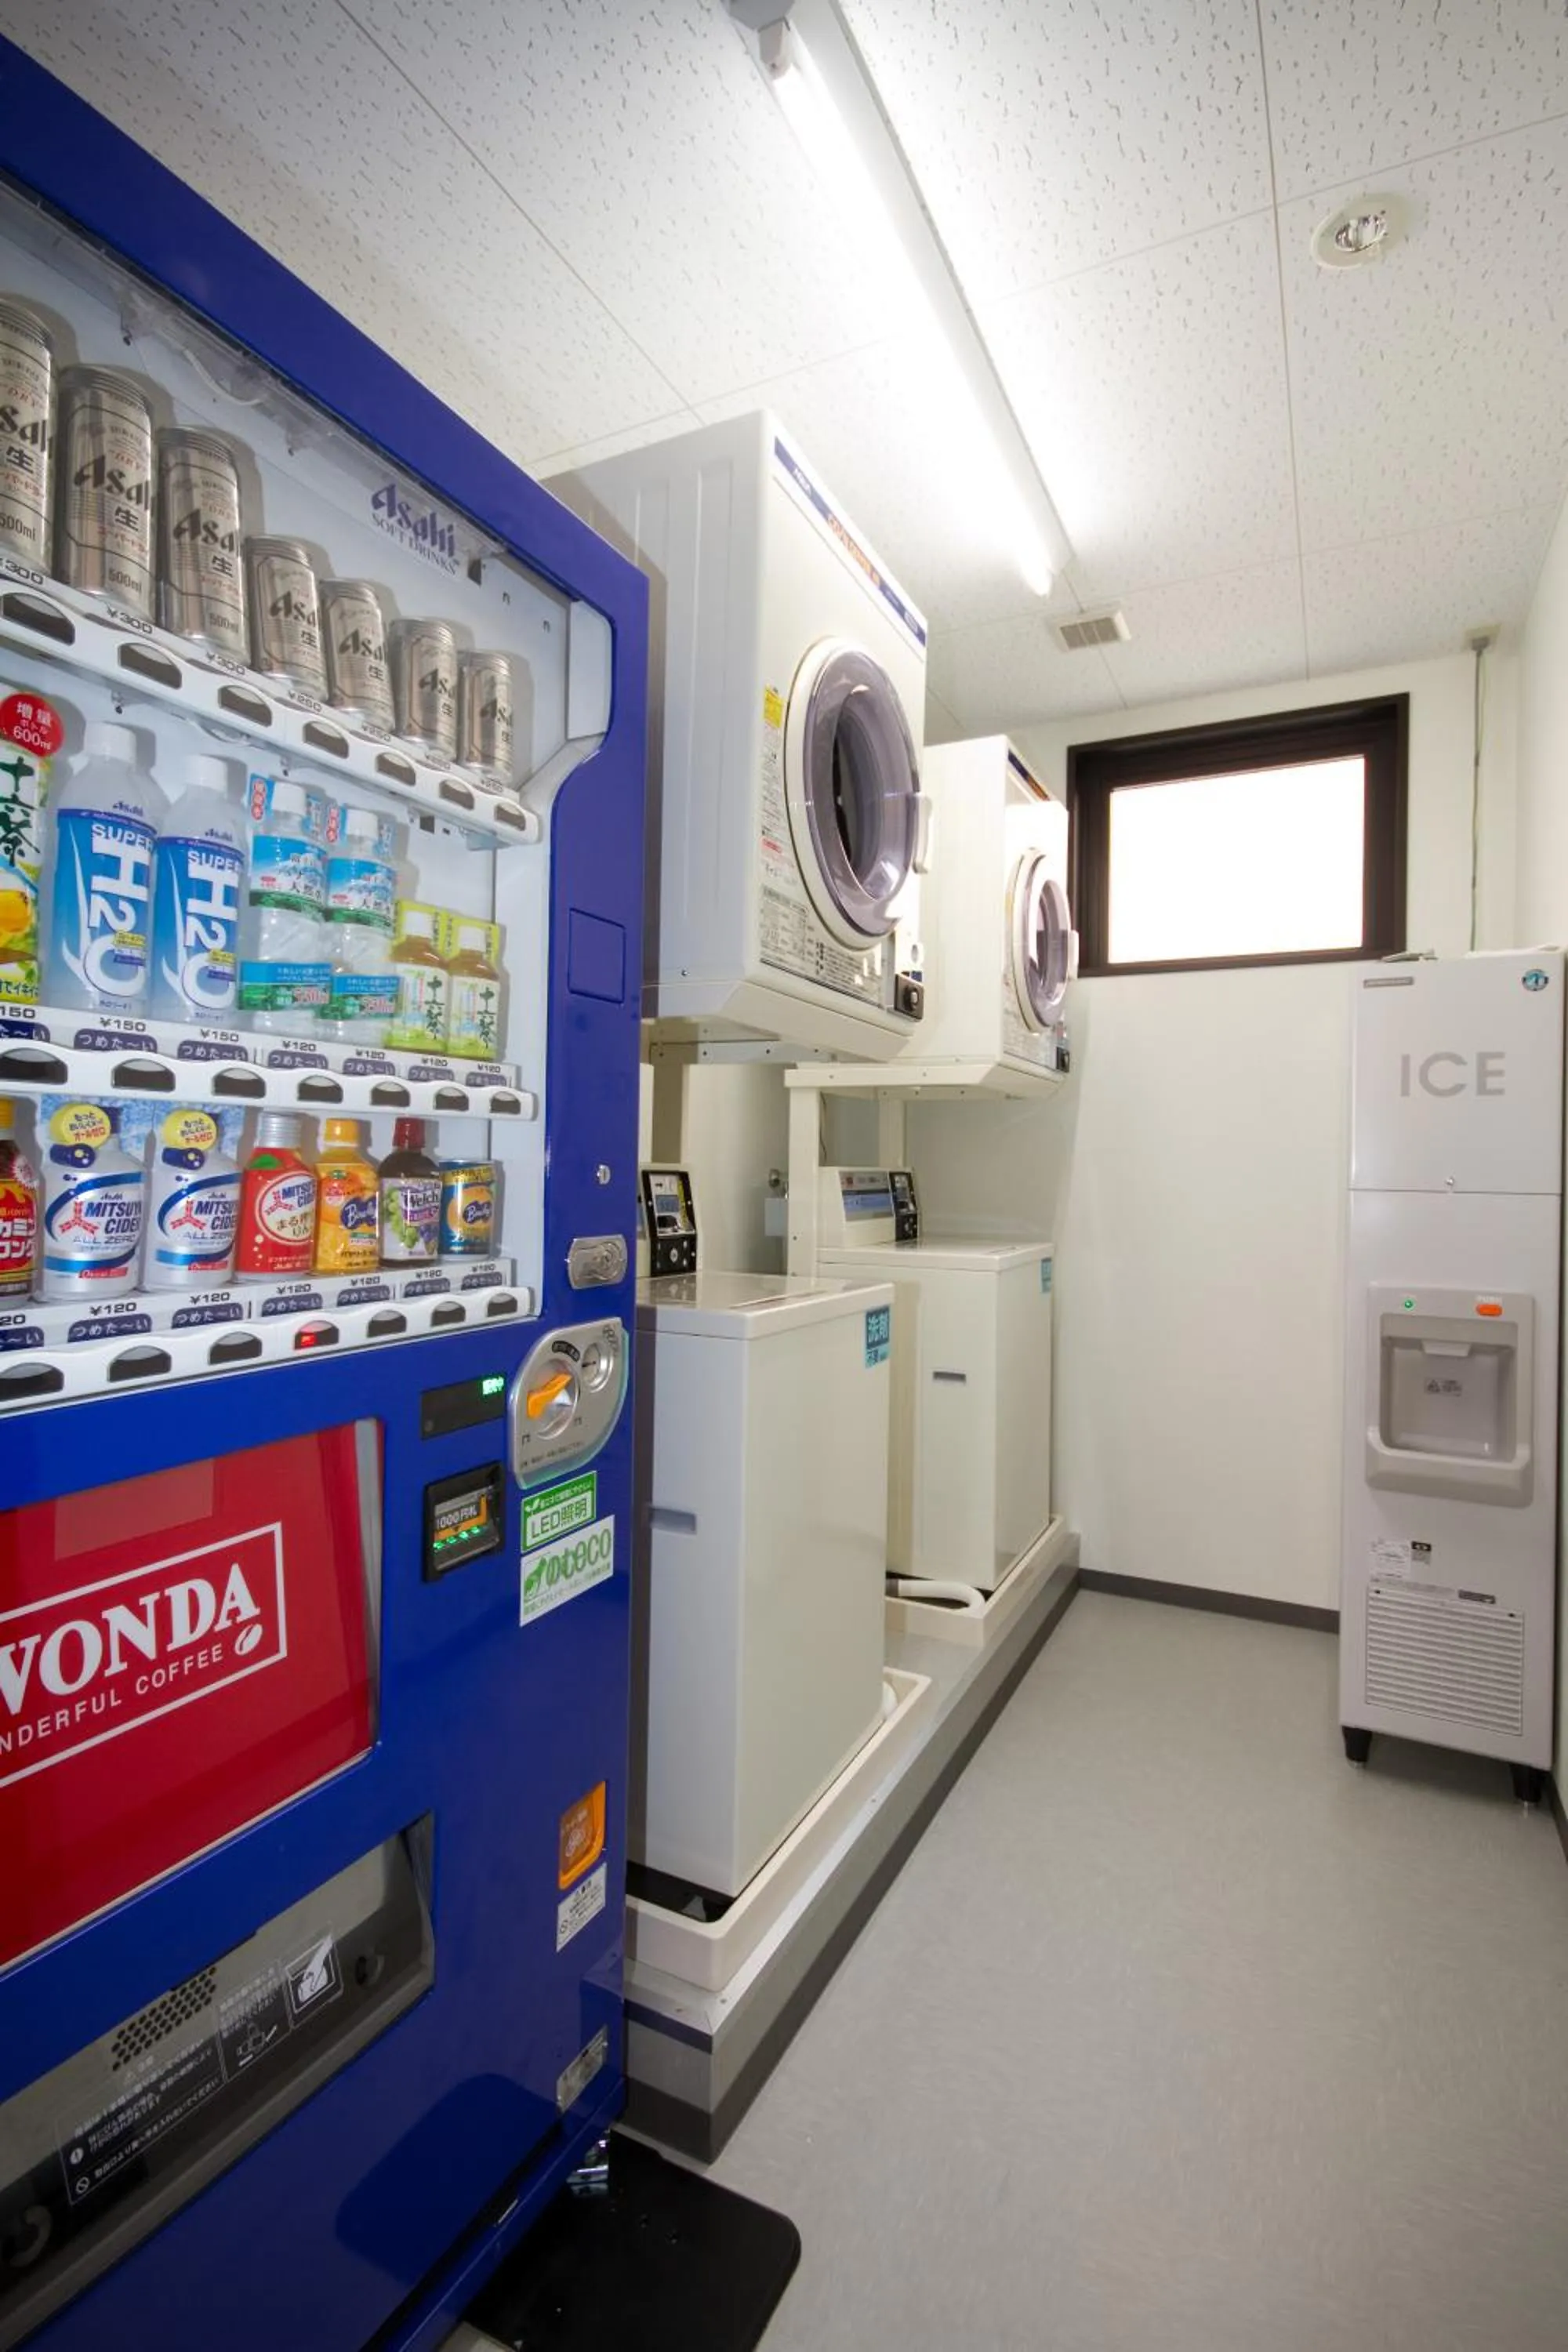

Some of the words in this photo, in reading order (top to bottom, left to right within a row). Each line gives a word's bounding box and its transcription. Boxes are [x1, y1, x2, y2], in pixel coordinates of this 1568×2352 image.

[6, 445, 34, 474] 生
[115, 506, 139, 532] 生
[371, 483, 455, 557] Asahi
[0, 558, 44, 585] 300
[212, 556, 233, 578] 生
[100, 1017, 147, 1033] ¥150
[200, 1028, 240, 1043] ¥150
[1399, 1051, 1506, 1098] ICE
[90, 1302, 137, 1316] ¥120
[190, 1292, 230, 1305] ¥120
[531, 1497, 588, 1539] LED照明
[135, 1642, 223, 1696] COFFEE
